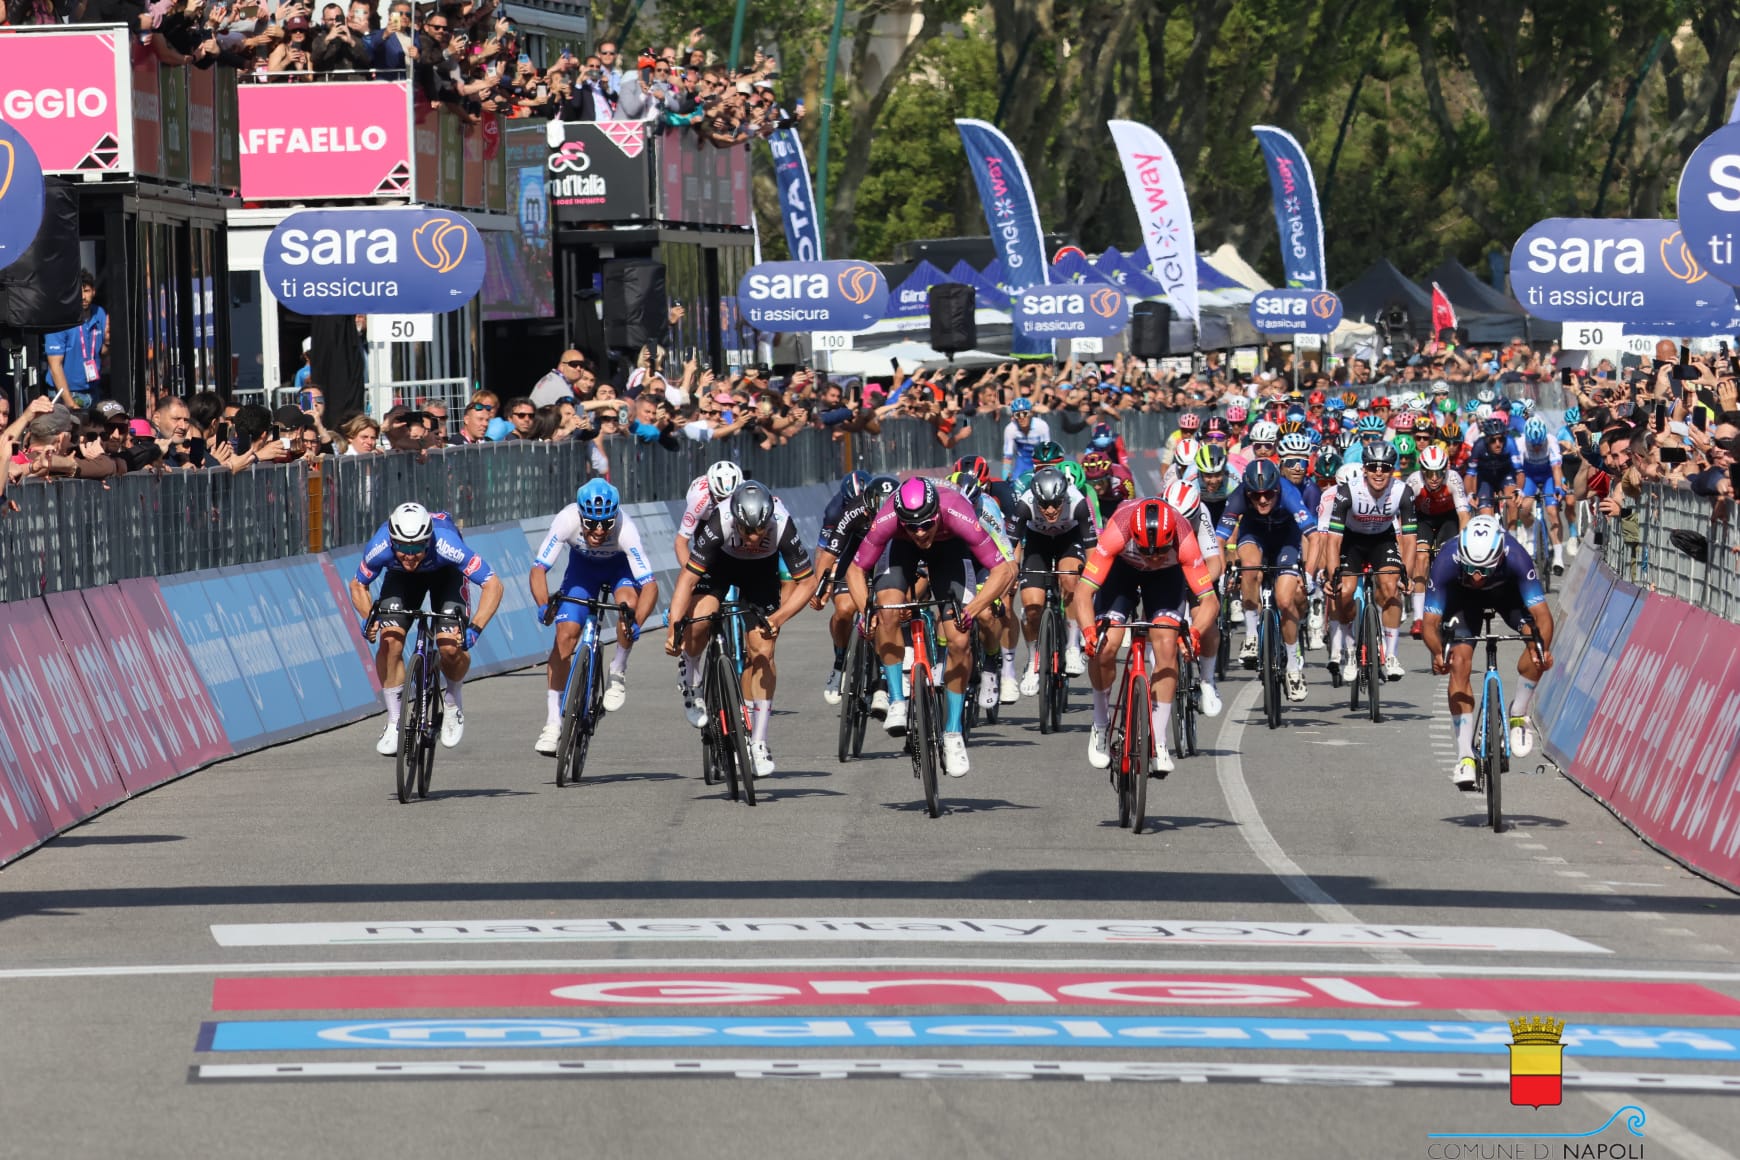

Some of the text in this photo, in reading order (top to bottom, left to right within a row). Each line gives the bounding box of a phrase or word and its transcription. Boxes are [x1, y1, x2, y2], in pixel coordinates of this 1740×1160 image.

[0, 87, 108, 119] GGIO
[1131, 152, 1169, 214] way
[280, 228, 398, 265] sara
[1527, 236, 1645, 275] sara
[1708, 234, 1732, 264] ti
[281, 277, 398, 298] ti assicura
[749, 274, 829, 300] sara
[1528, 286, 1645, 307] ti assicura
[749, 307, 829, 321] ti assicura
[1022, 294, 1084, 315] sara
[1256, 296, 1308, 315] sara
[391, 321, 415, 338] 50
[1023, 319, 1085, 332] ti assicura
[821, 335, 845, 348] 100
[1578, 328, 1604, 346] 50
[1628, 338, 1652, 351] 100
[1357, 502, 1393, 516] UAE
[835, 505, 865, 536] youfone
[436, 537, 466, 562] Alpecin
[363, 920, 1444, 940] madeinitaly.gov.it
[550, 976, 1422, 1007] enel
